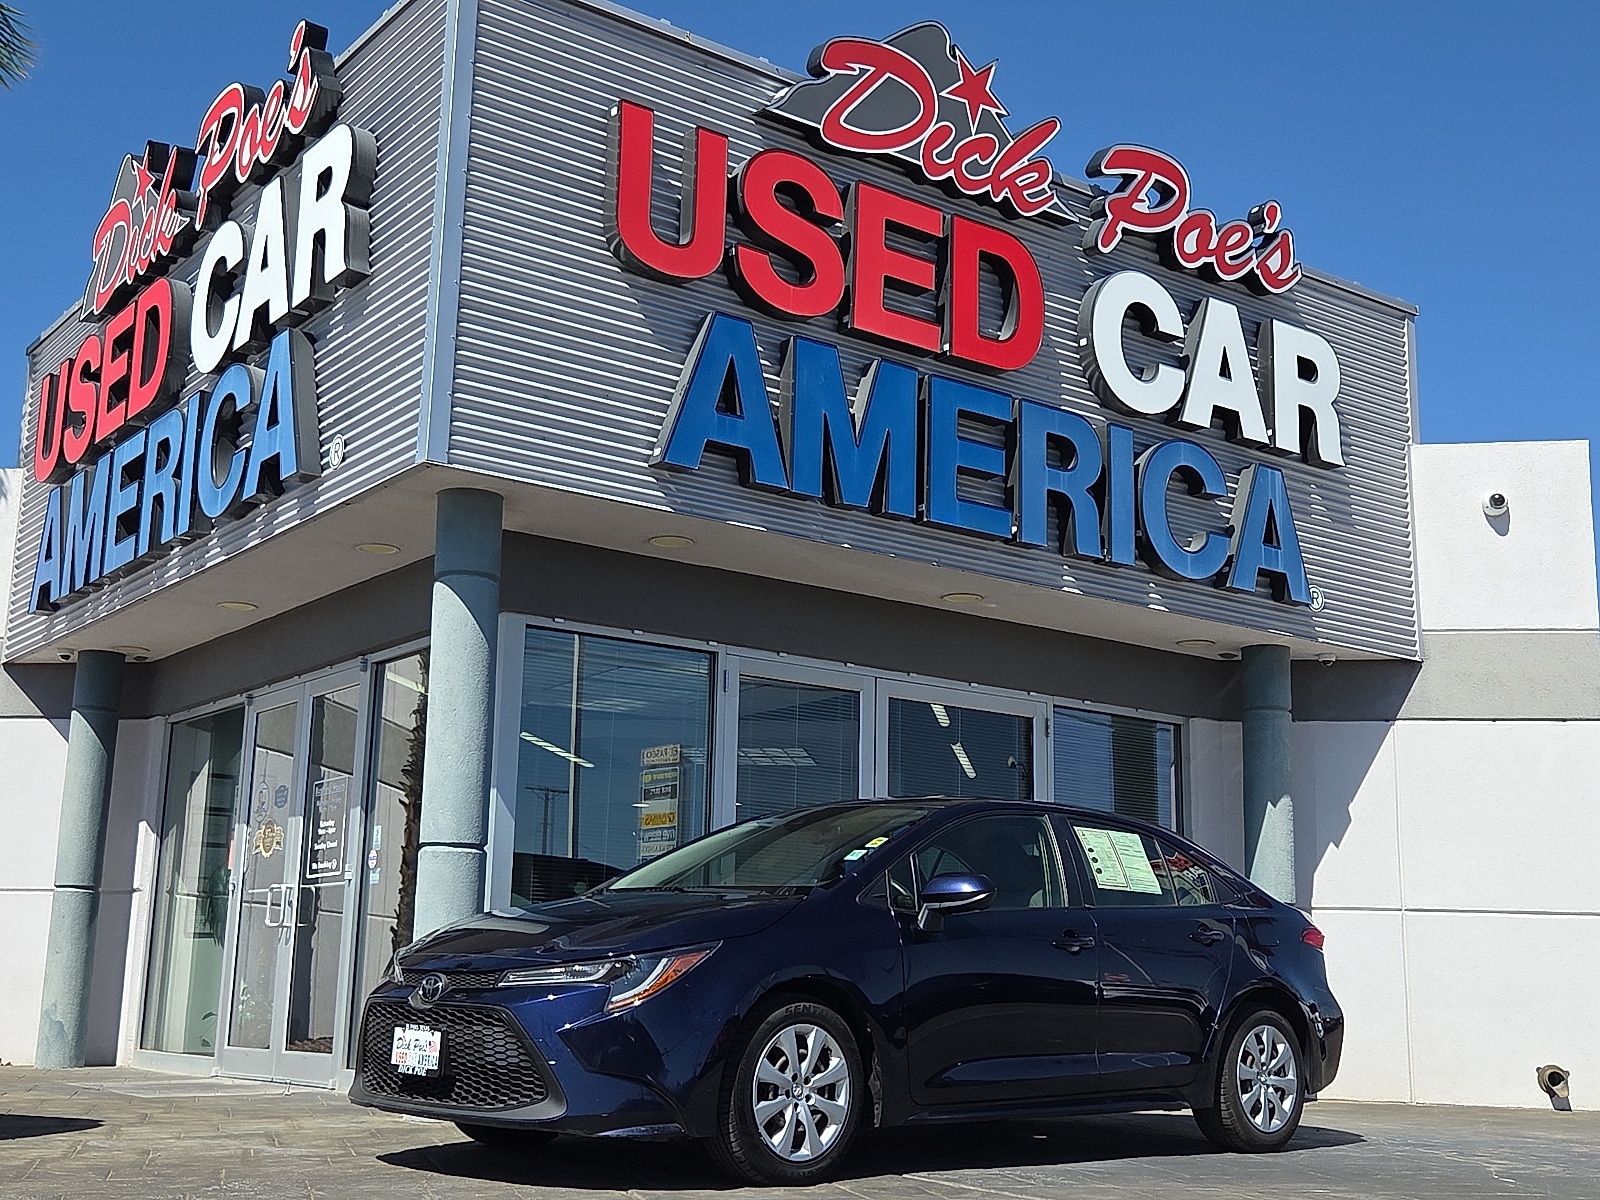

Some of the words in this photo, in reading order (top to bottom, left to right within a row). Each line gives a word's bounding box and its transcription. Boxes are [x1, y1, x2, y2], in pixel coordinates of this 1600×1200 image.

[34, 278, 173, 484] USED
[191, 124, 356, 374] CAR
[92, 145, 178, 315] Dick
[195, 20, 319, 231] Poe's
[614, 99, 1045, 372] USED
[1090, 270, 1345, 467] CAR
[820, 37, 1061, 217] Dick
[1098, 145, 1301, 293] Poe's
[28, 328, 299, 614] AMERICA
[663, 311, 1311, 605] AMERICA
